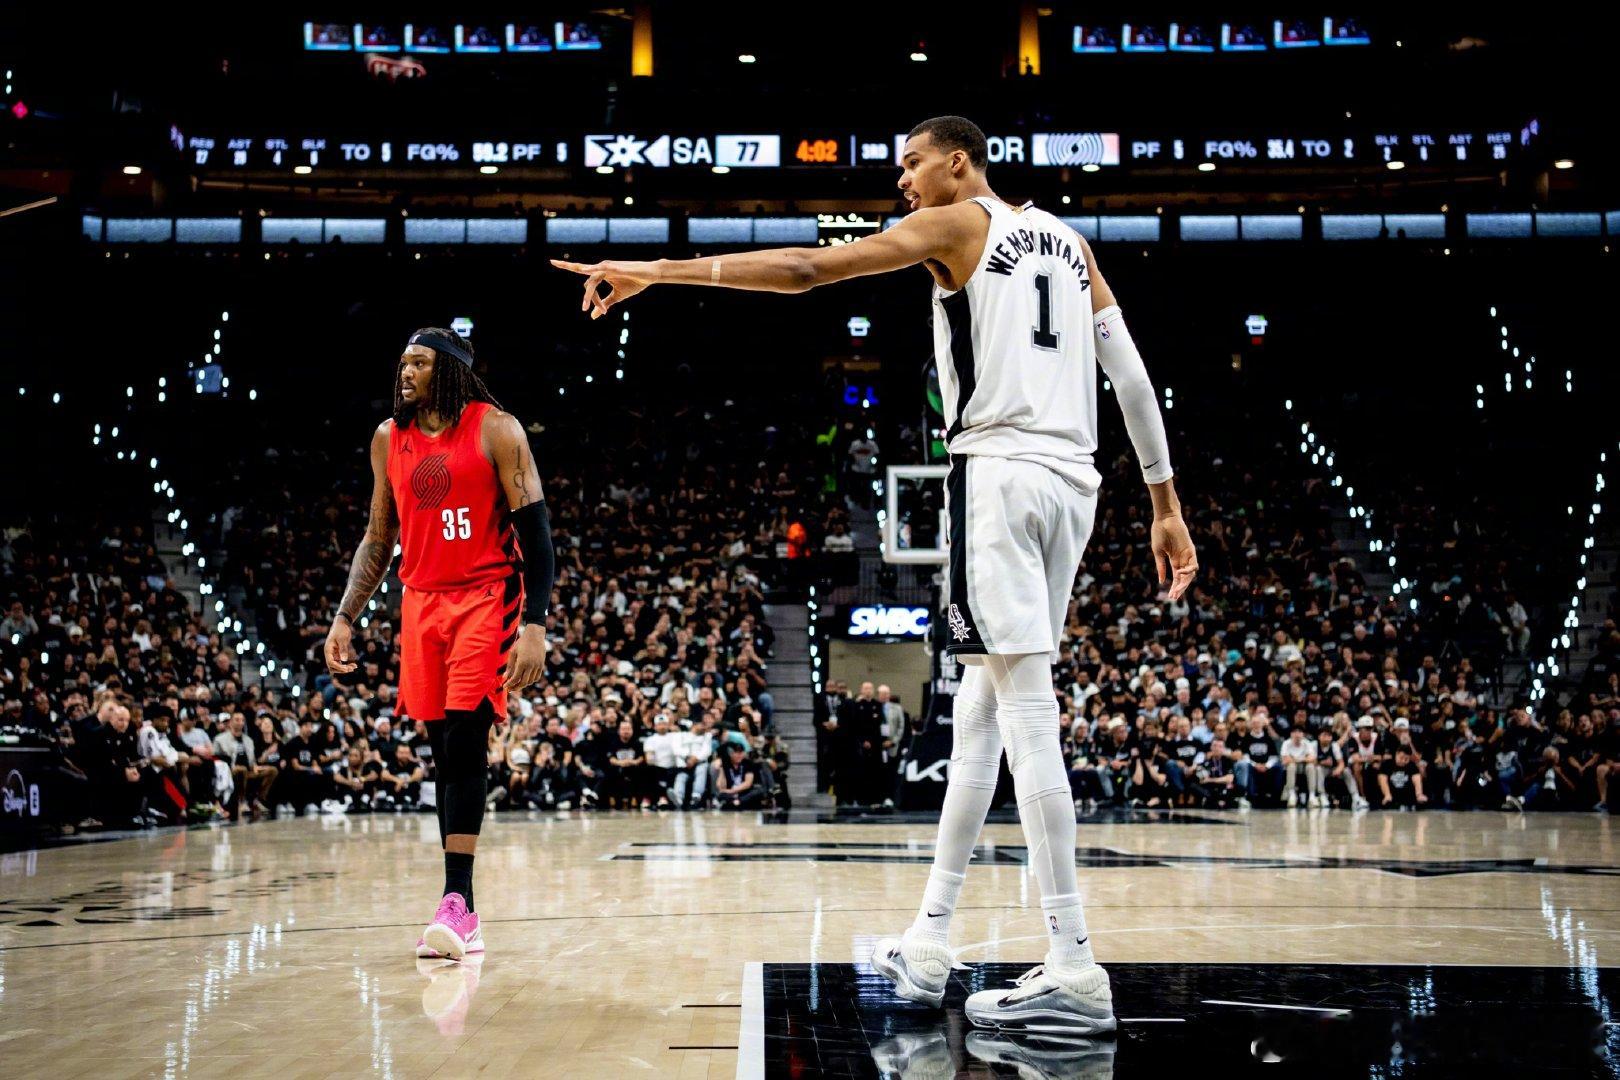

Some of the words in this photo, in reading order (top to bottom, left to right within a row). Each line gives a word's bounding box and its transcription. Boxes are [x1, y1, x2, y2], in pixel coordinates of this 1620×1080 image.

[340, 144, 370, 161] TO
[407, 144, 459, 161] FG%
[513, 144, 541, 161] PF
[673, 137, 712, 164] SA
[737, 142, 760, 162] 77
[796, 139, 837, 162] 4:02
[987, 136, 1024, 162] OR
[1132, 142, 1160, 158] PF
[1205, 141, 1257, 158] FG%
[1302, 140, 1331, 157] TO
[1031, 271, 1060, 353] 1
[441, 507, 471, 540] 35
